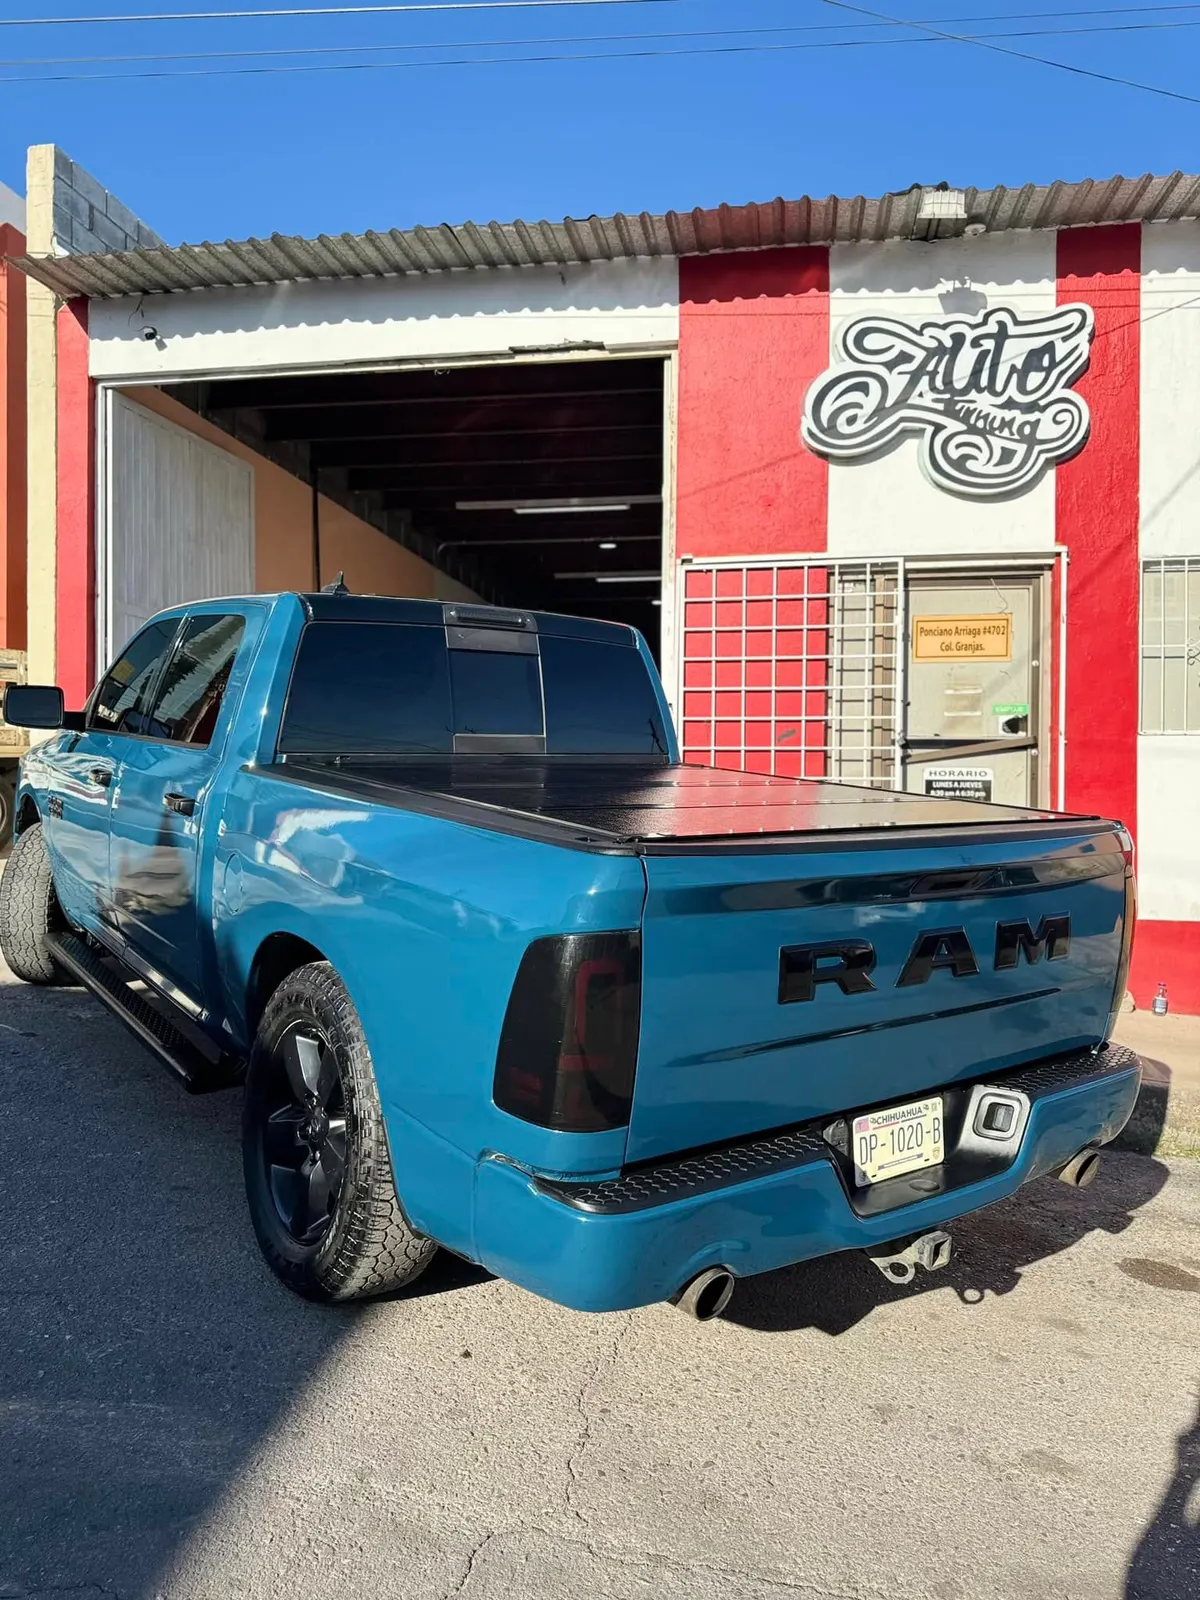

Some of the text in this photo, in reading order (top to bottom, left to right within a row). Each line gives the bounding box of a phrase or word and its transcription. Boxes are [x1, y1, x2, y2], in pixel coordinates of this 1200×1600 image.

[919, 625, 1006, 638] Ponciano Arriaga #4702
[940, 641, 985, 653] Col. Granjas.
[778, 910, 1071, 1005] RAM
[876, 1106, 923, 1125] CHIHUAHUA
[859, 1117, 941, 1166] DP-1020-B
